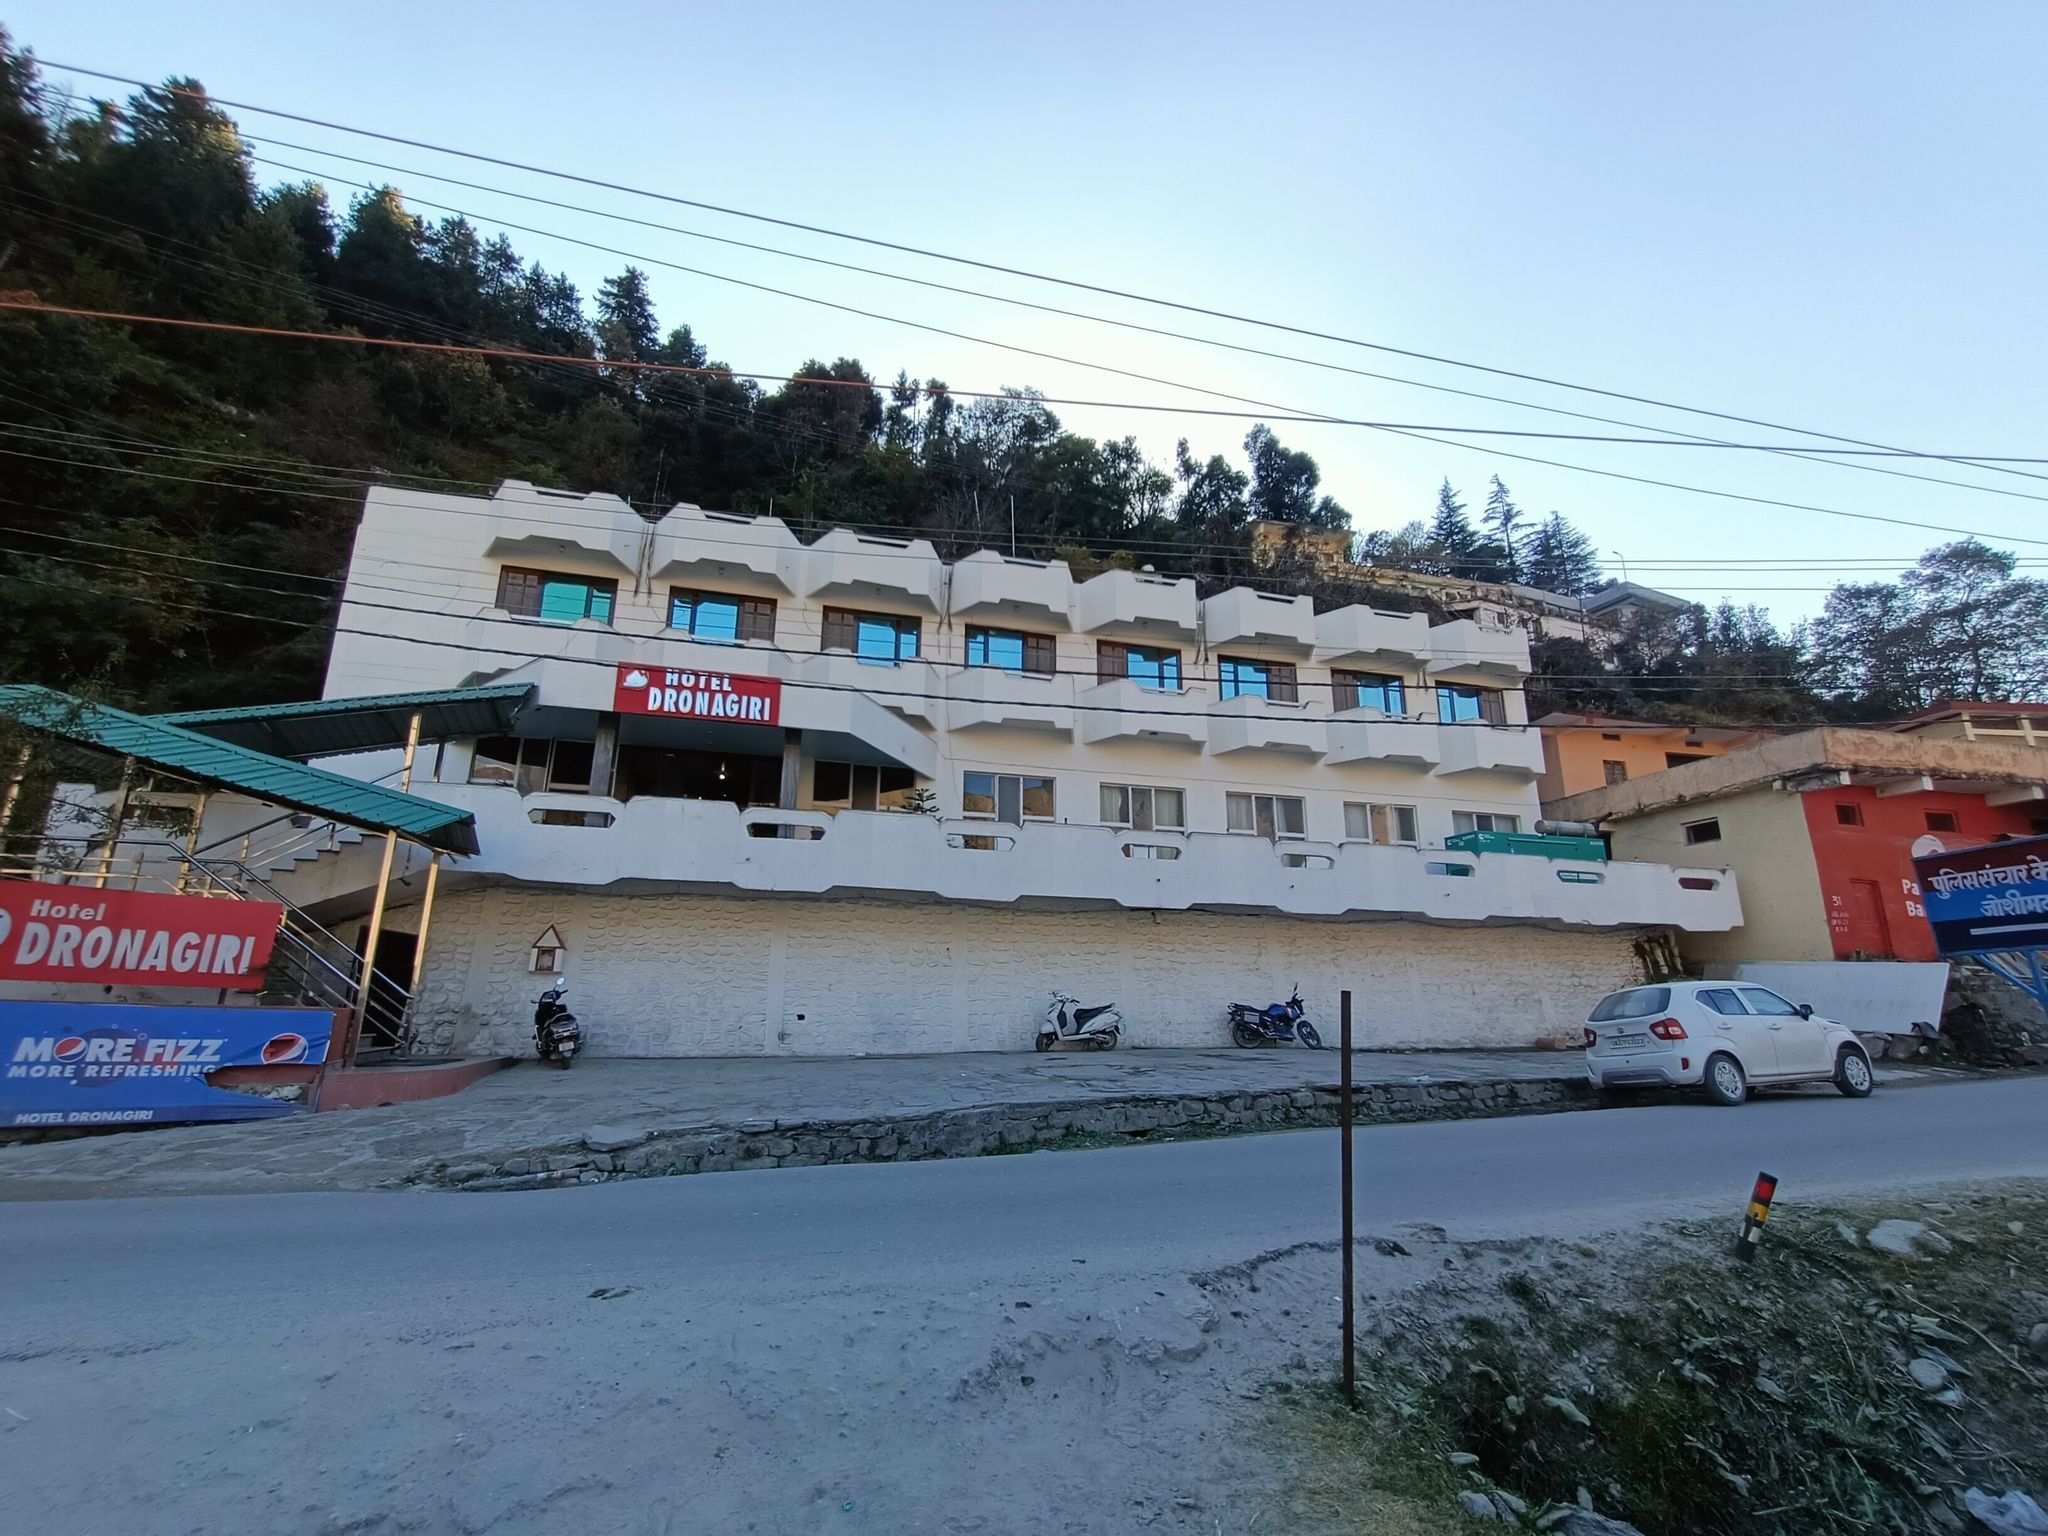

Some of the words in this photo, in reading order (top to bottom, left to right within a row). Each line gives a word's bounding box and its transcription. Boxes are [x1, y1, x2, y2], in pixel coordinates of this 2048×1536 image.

[665, 668, 732, 692] HOTEL
[647, 687, 771, 721] DRONAGIRI
[1901, 879, 1920, 896] Pa
[30, 899, 107, 921] Hotel
[1905, 900, 1927, 917] Ba
[15, 921, 255, 975] DRONAGIRI
[13, 1037, 140, 1063] MORE
[143, 1039, 225, 1062] FIZZ
[8, 1065, 76, 1078] MORE
[84, 1065, 216, 1077] REFRESHING
[16, 1112, 64, 1124] HOTEL
[68, 1110, 153, 1122] DRONAGIRI
